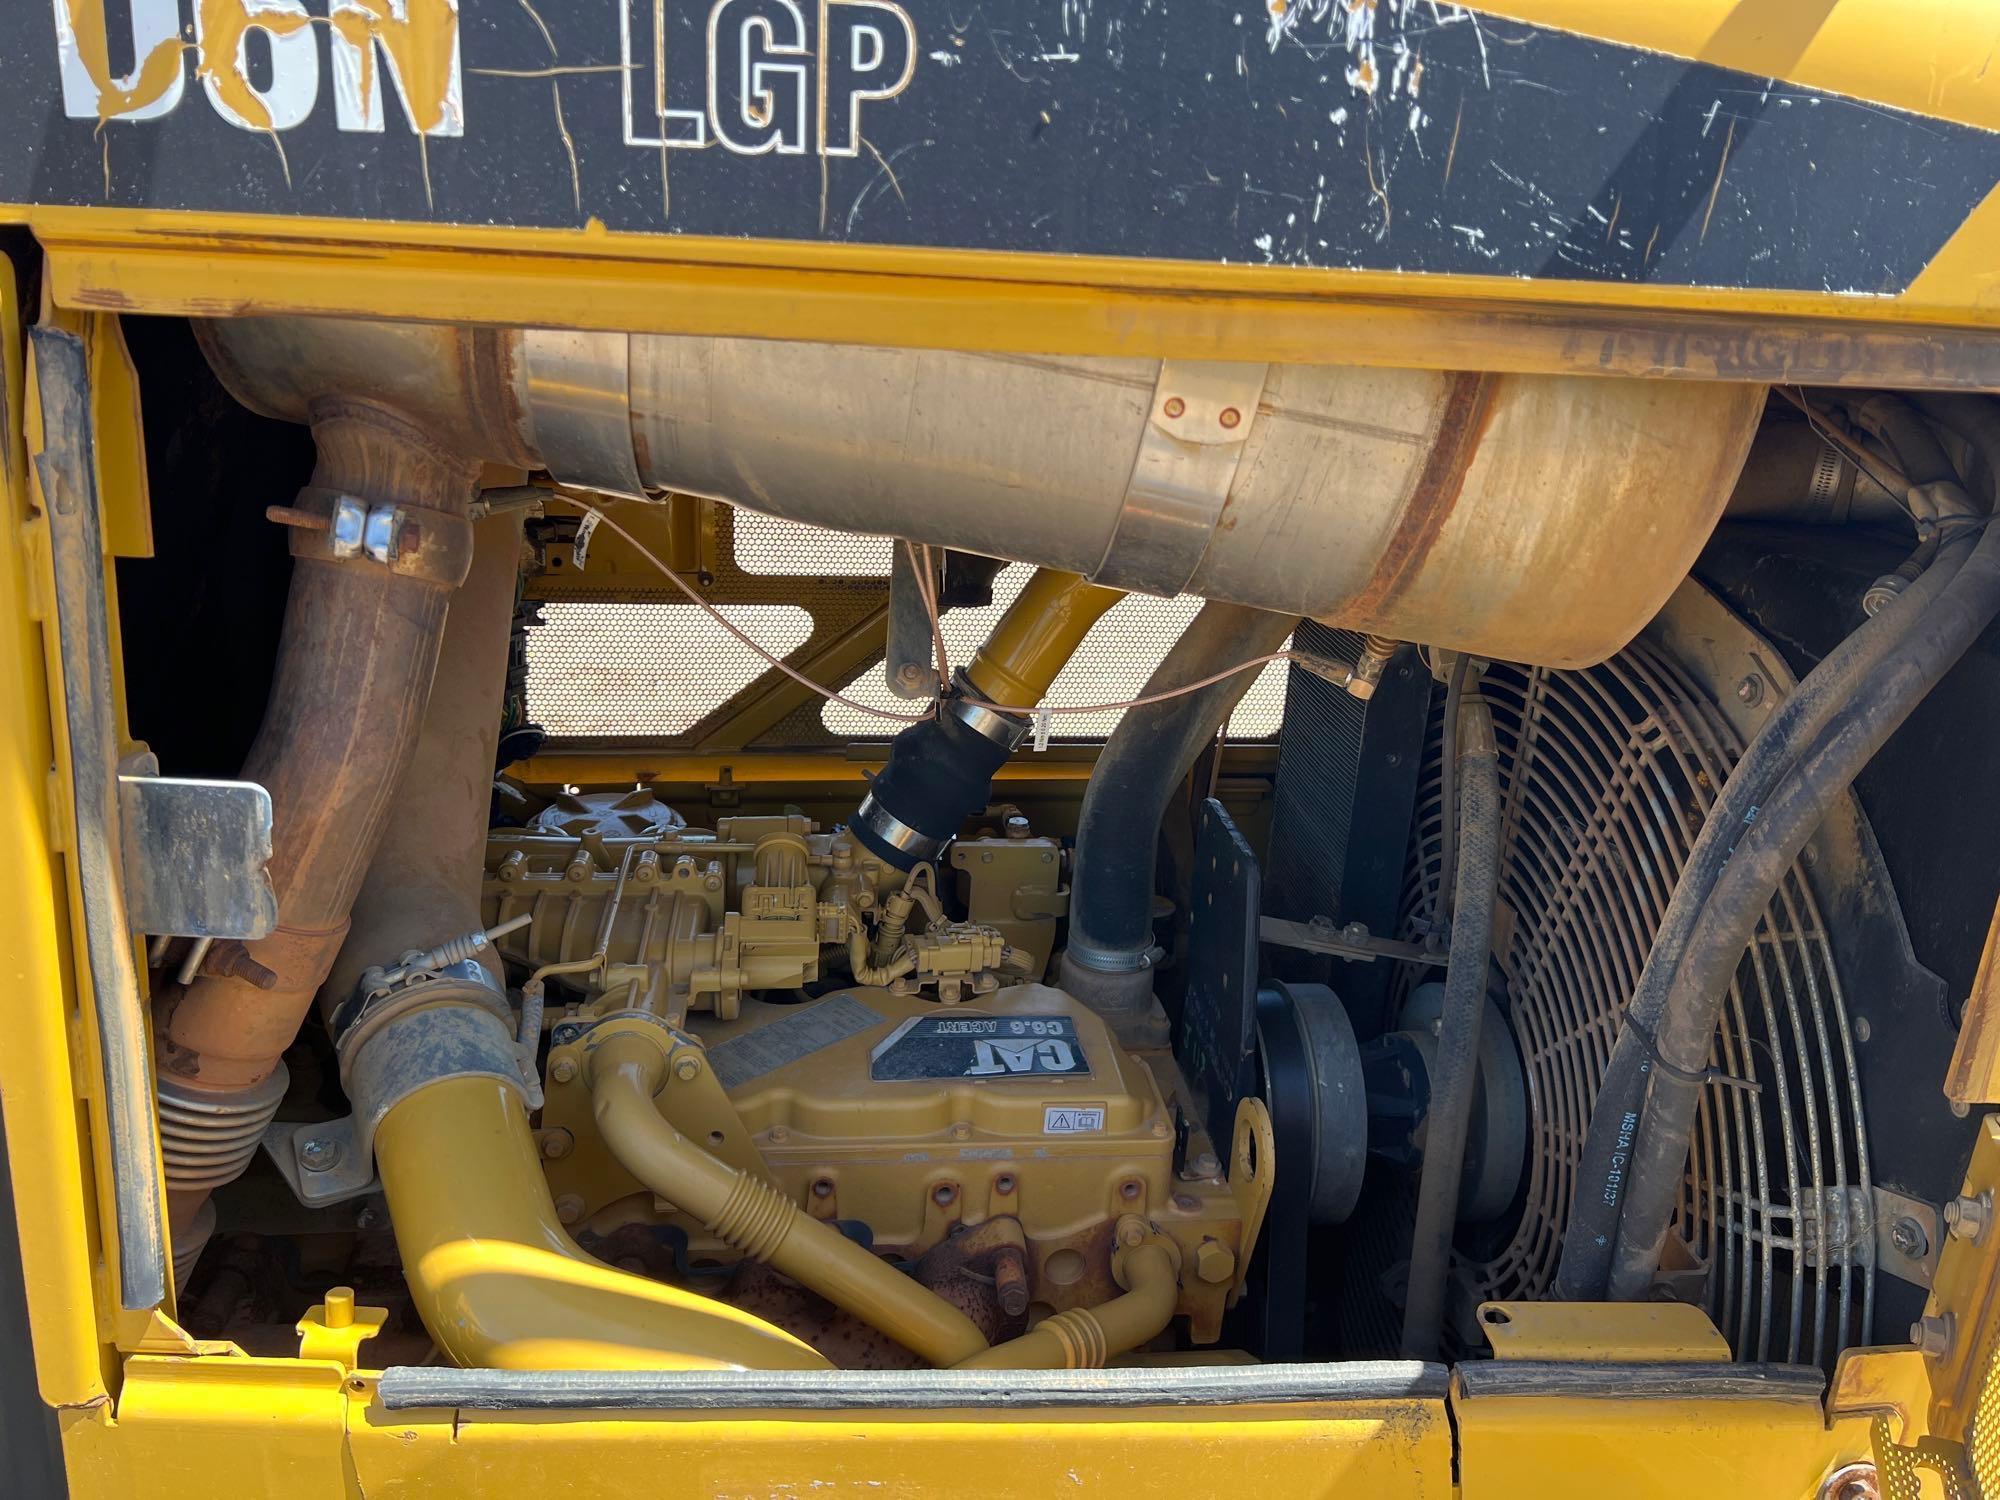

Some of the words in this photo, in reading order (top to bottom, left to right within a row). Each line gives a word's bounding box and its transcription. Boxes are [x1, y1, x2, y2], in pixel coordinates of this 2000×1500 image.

[619, 0, 917, 156] LGP
[936, 1021, 997, 1034] ACERT
[1009, 1021, 1064, 1035] C6.6
[971, 1038, 1077, 1074] CAT
[1616, 1111, 1637, 1148] MSHA
